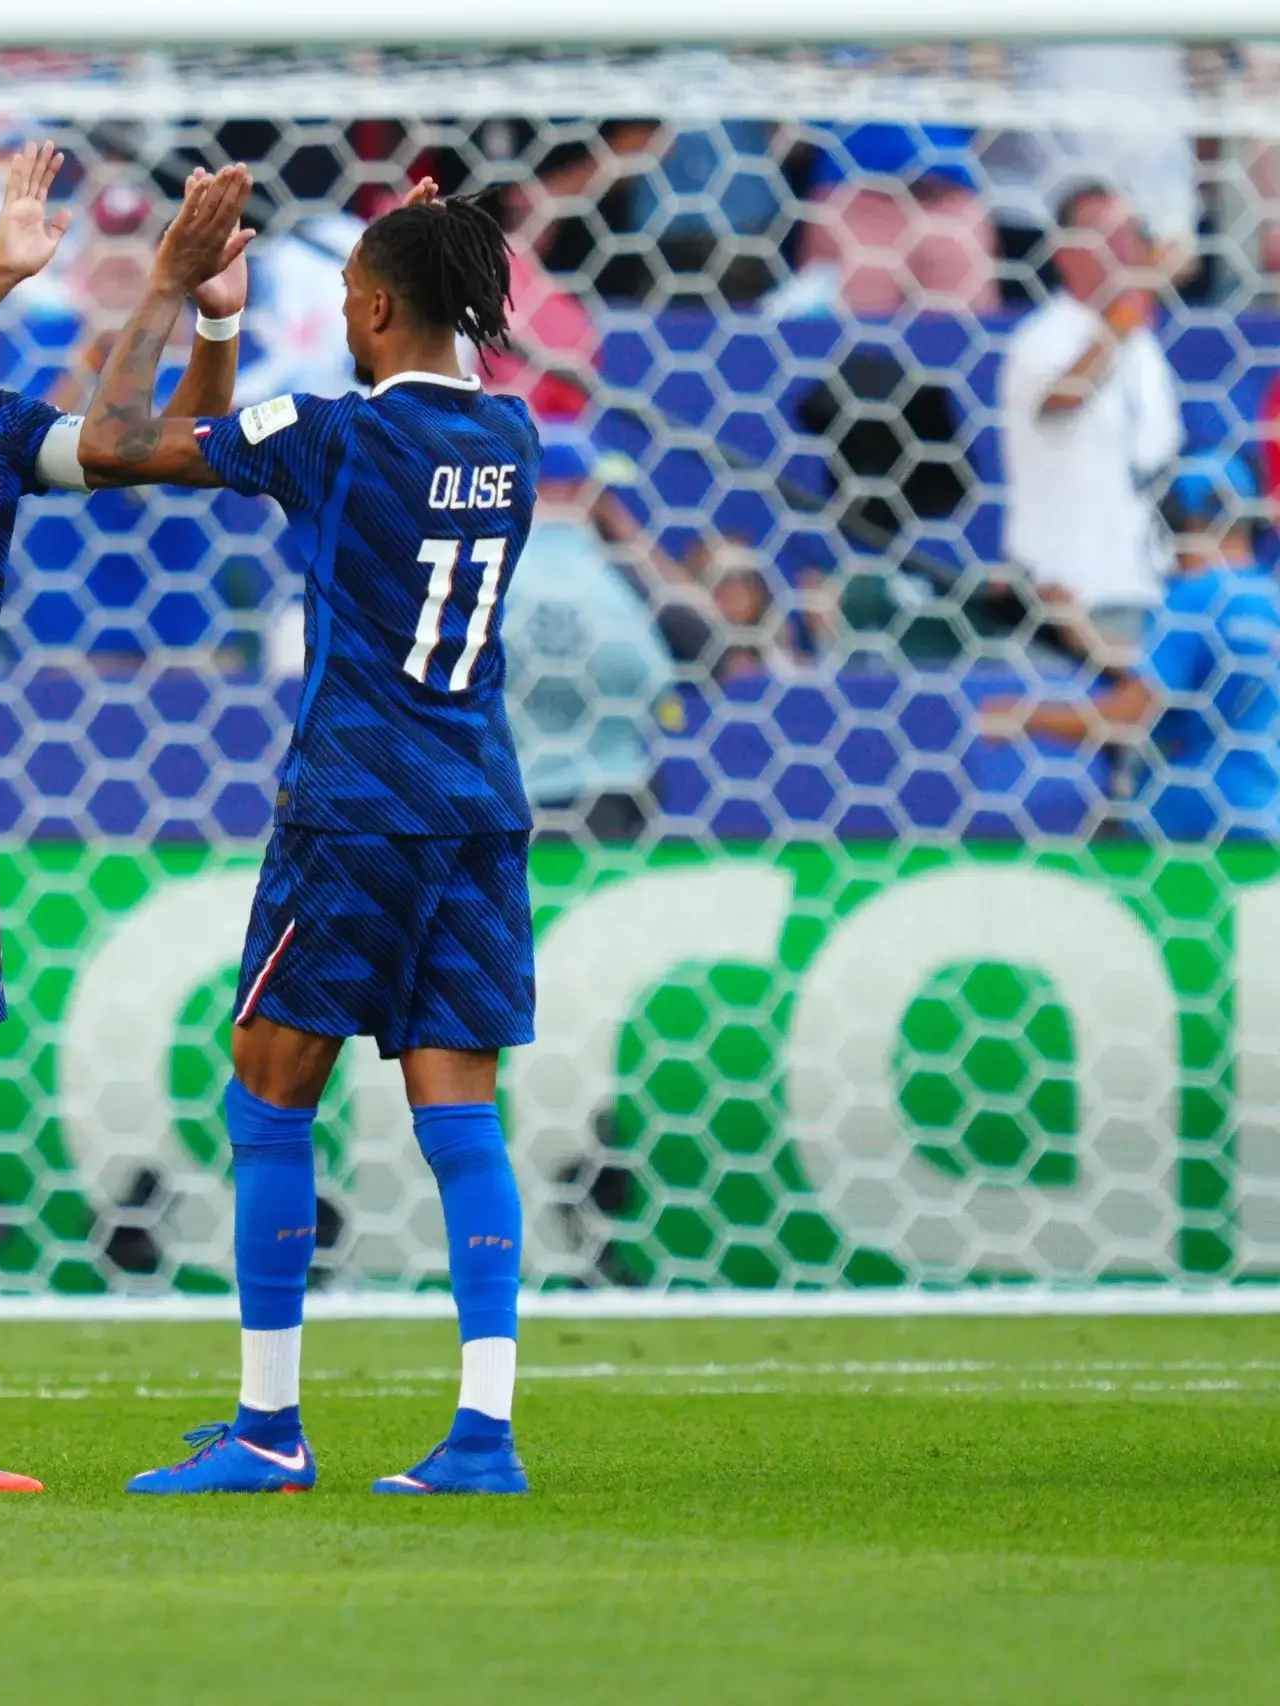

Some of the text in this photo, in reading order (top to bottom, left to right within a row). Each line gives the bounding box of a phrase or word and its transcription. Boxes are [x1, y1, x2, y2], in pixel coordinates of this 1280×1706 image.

[427, 464, 517, 511] OLISE
[402, 537, 508, 692] 11
[57, 860, 1280, 1281] ara
